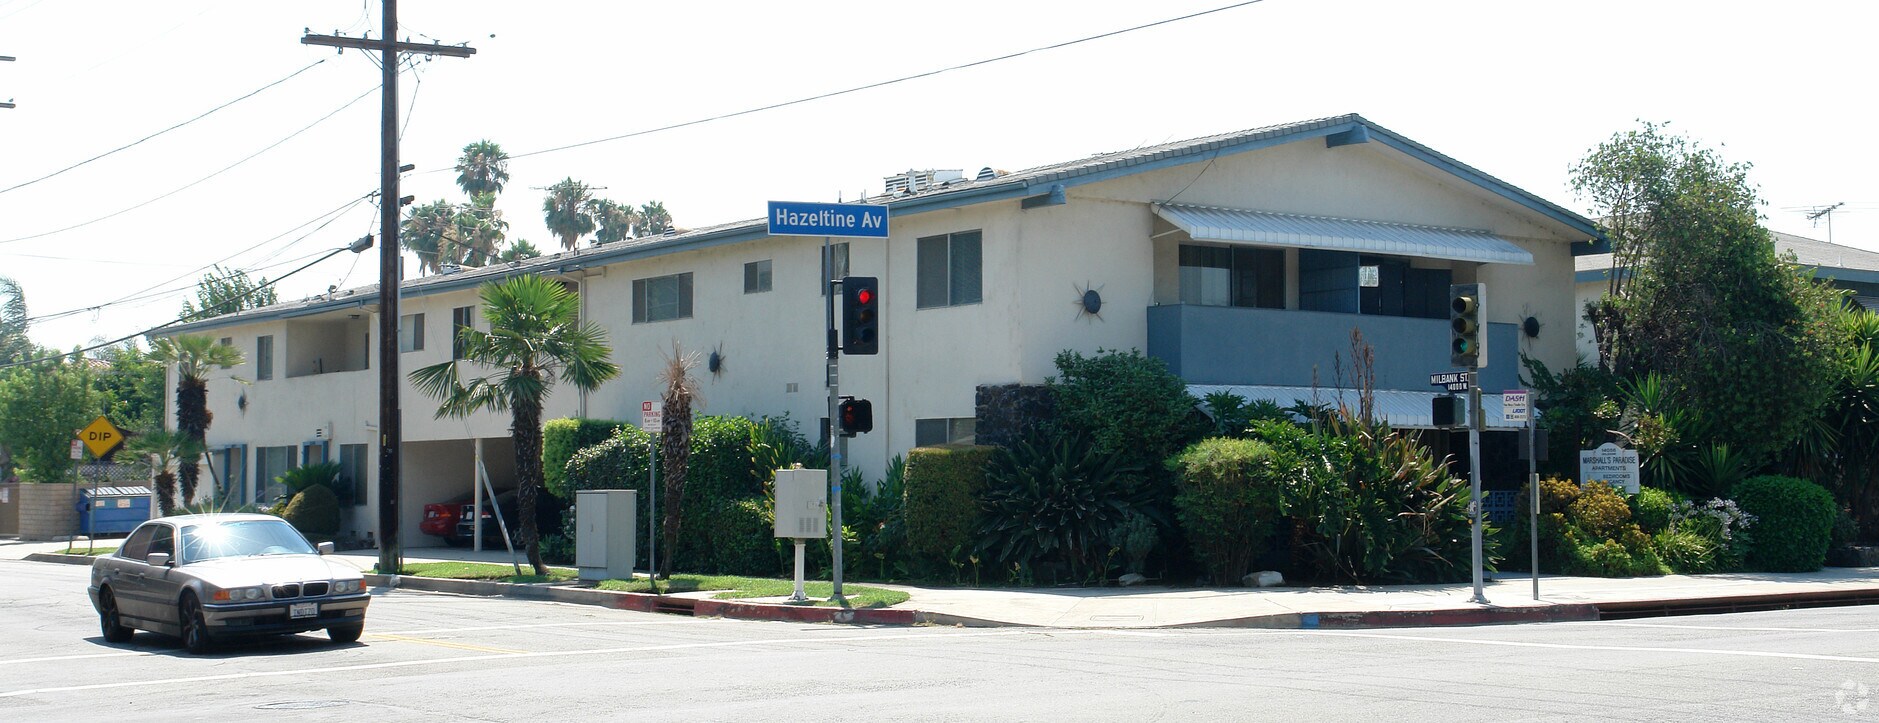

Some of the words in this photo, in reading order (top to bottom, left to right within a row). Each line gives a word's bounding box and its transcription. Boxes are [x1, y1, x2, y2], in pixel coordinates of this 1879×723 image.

[776, 208, 856, 228] Hazeltine
[861, 211, 882, 229] Av
[1431, 373, 1459, 384] MILBANK
[89, 431, 112, 441] DIP
[1582, 456, 1612, 464] MARSHALL'S
[1612, 456, 1636, 464] PARADISE
